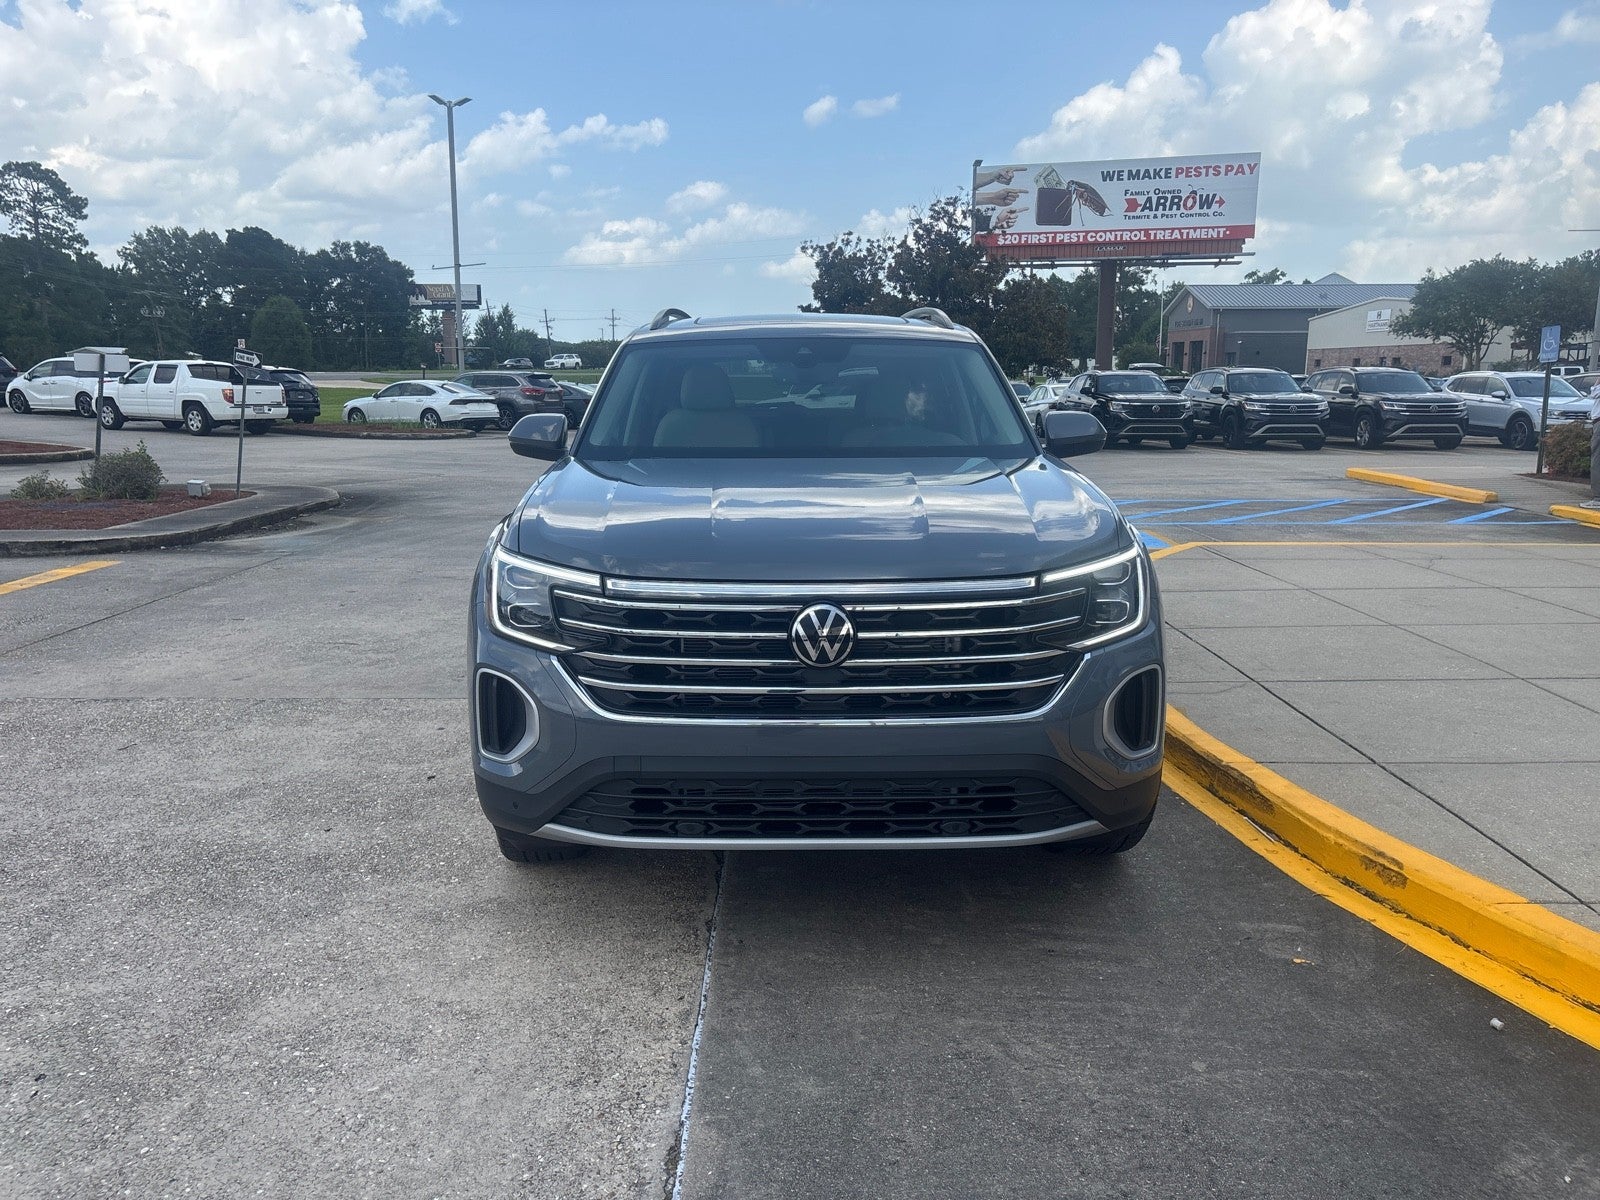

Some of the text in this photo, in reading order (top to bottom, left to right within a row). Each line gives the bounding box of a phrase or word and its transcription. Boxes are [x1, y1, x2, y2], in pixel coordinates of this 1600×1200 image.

[1101, 162, 1258, 182] WE MAKE PESTS PAY
[1140, 193, 1217, 212] ARROW
[997, 233, 1019, 245] $20
[1021, 234, 1054, 244] FIRST
[1056, 233, 1085, 243] PEST
[1086, 230, 1146, 242] CONTROL
[791, 603, 854, 668] VW
